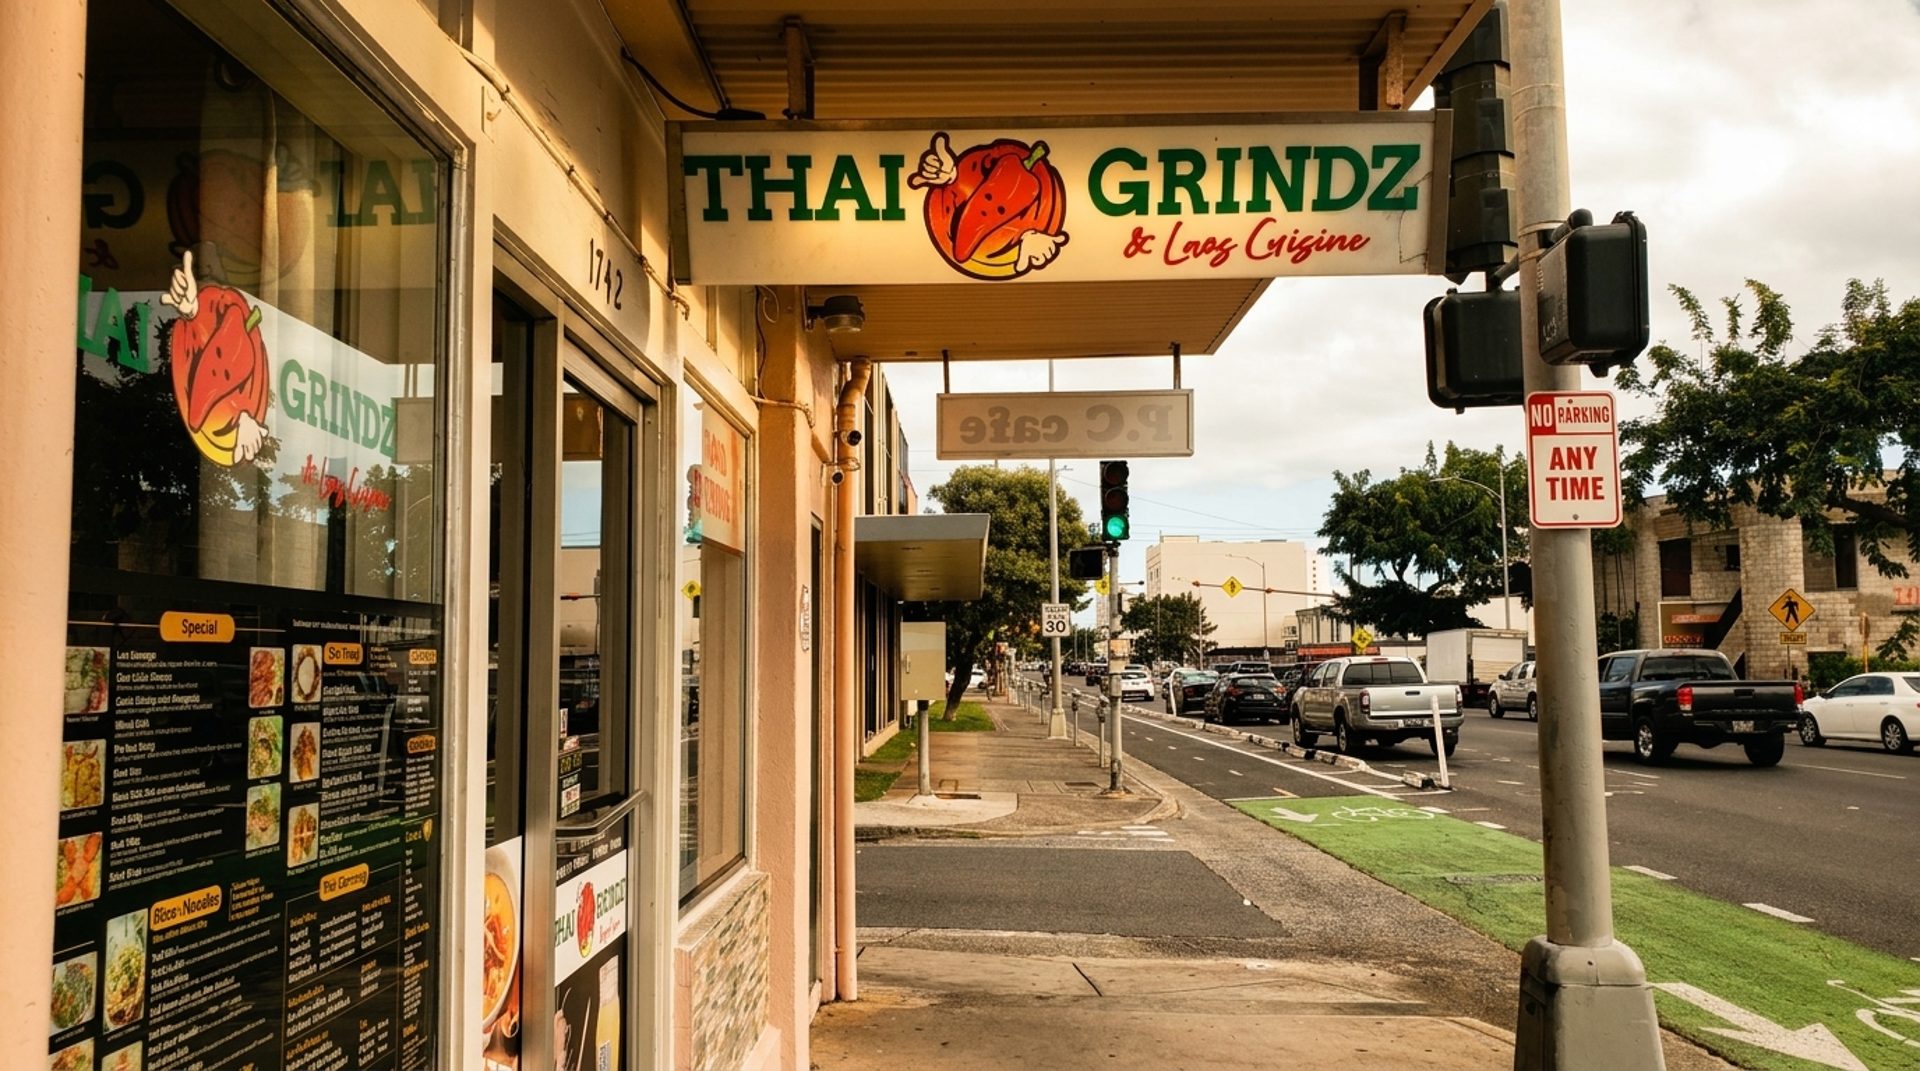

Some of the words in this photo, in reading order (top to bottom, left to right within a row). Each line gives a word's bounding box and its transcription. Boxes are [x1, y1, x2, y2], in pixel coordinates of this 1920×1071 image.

[685, 153, 905, 222] THAI
[1087, 143, 1421, 218] GRINDZ
[1124, 226, 1156, 259] &
[1163, 220, 1238, 268] Laos
[1245, 217, 1371, 264] Cuisine
[588, 237, 623, 311] 1742
[279, 359, 396, 458] GRINDZ
[1531, 404, 1553, 427] NO
[1558, 406, 1610, 423] PARKING
[1549, 446, 1598, 471] ANY
[1545, 476, 1605, 501] TIME
[182, 619, 217, 637] Special
[1045, 620, 1066, 633] 30
